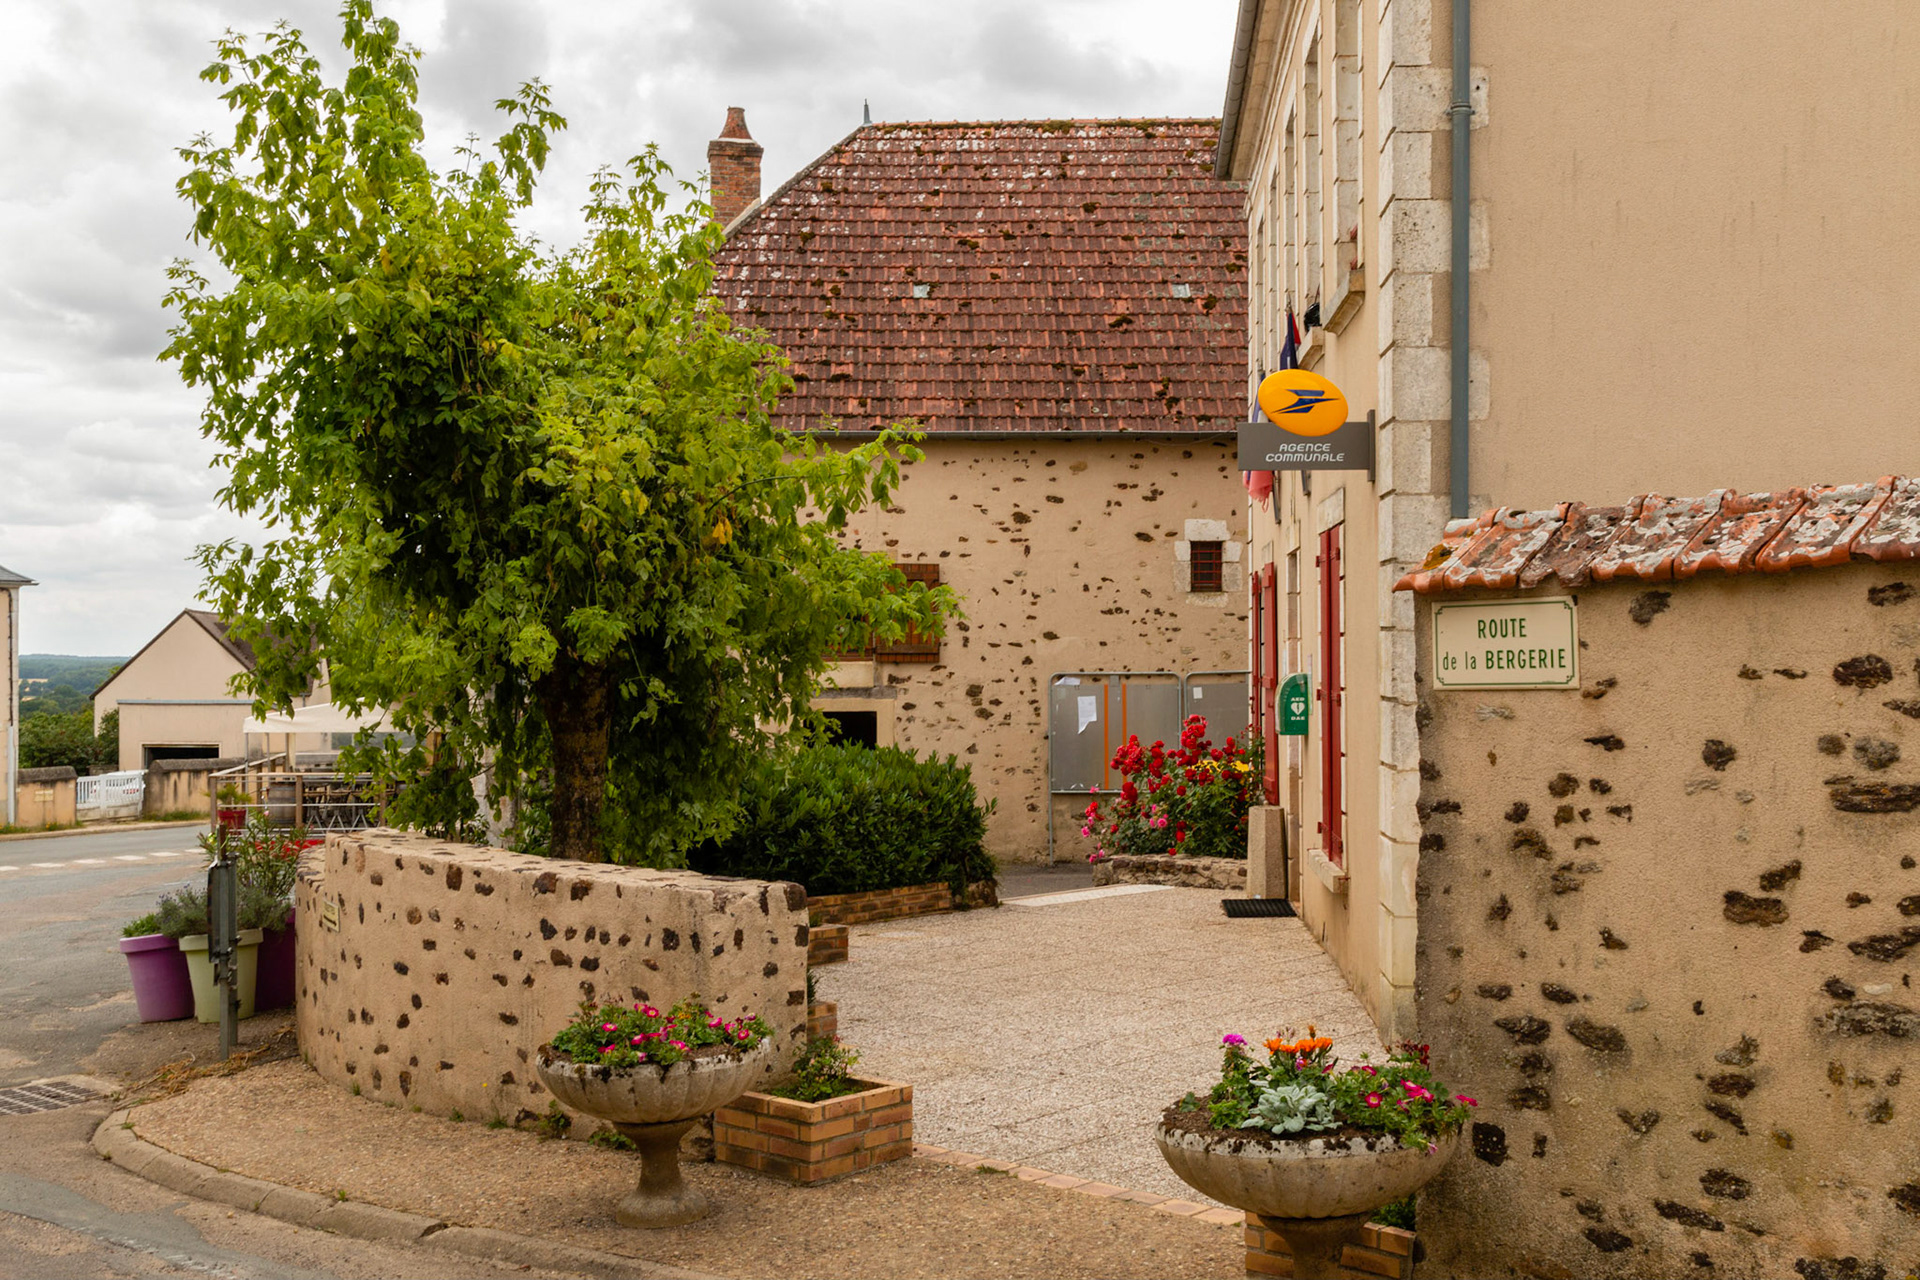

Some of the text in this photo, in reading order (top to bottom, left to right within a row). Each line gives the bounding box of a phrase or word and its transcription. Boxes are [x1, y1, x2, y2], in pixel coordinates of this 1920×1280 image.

[1279, 443, 1331, 452] AGENCE
[1265, 453, 1345, 462] COMMUNALE
[1477, 617, 1527, 638] ROUTE
[1443, 648, 1566, 670] de la BERGERIE
